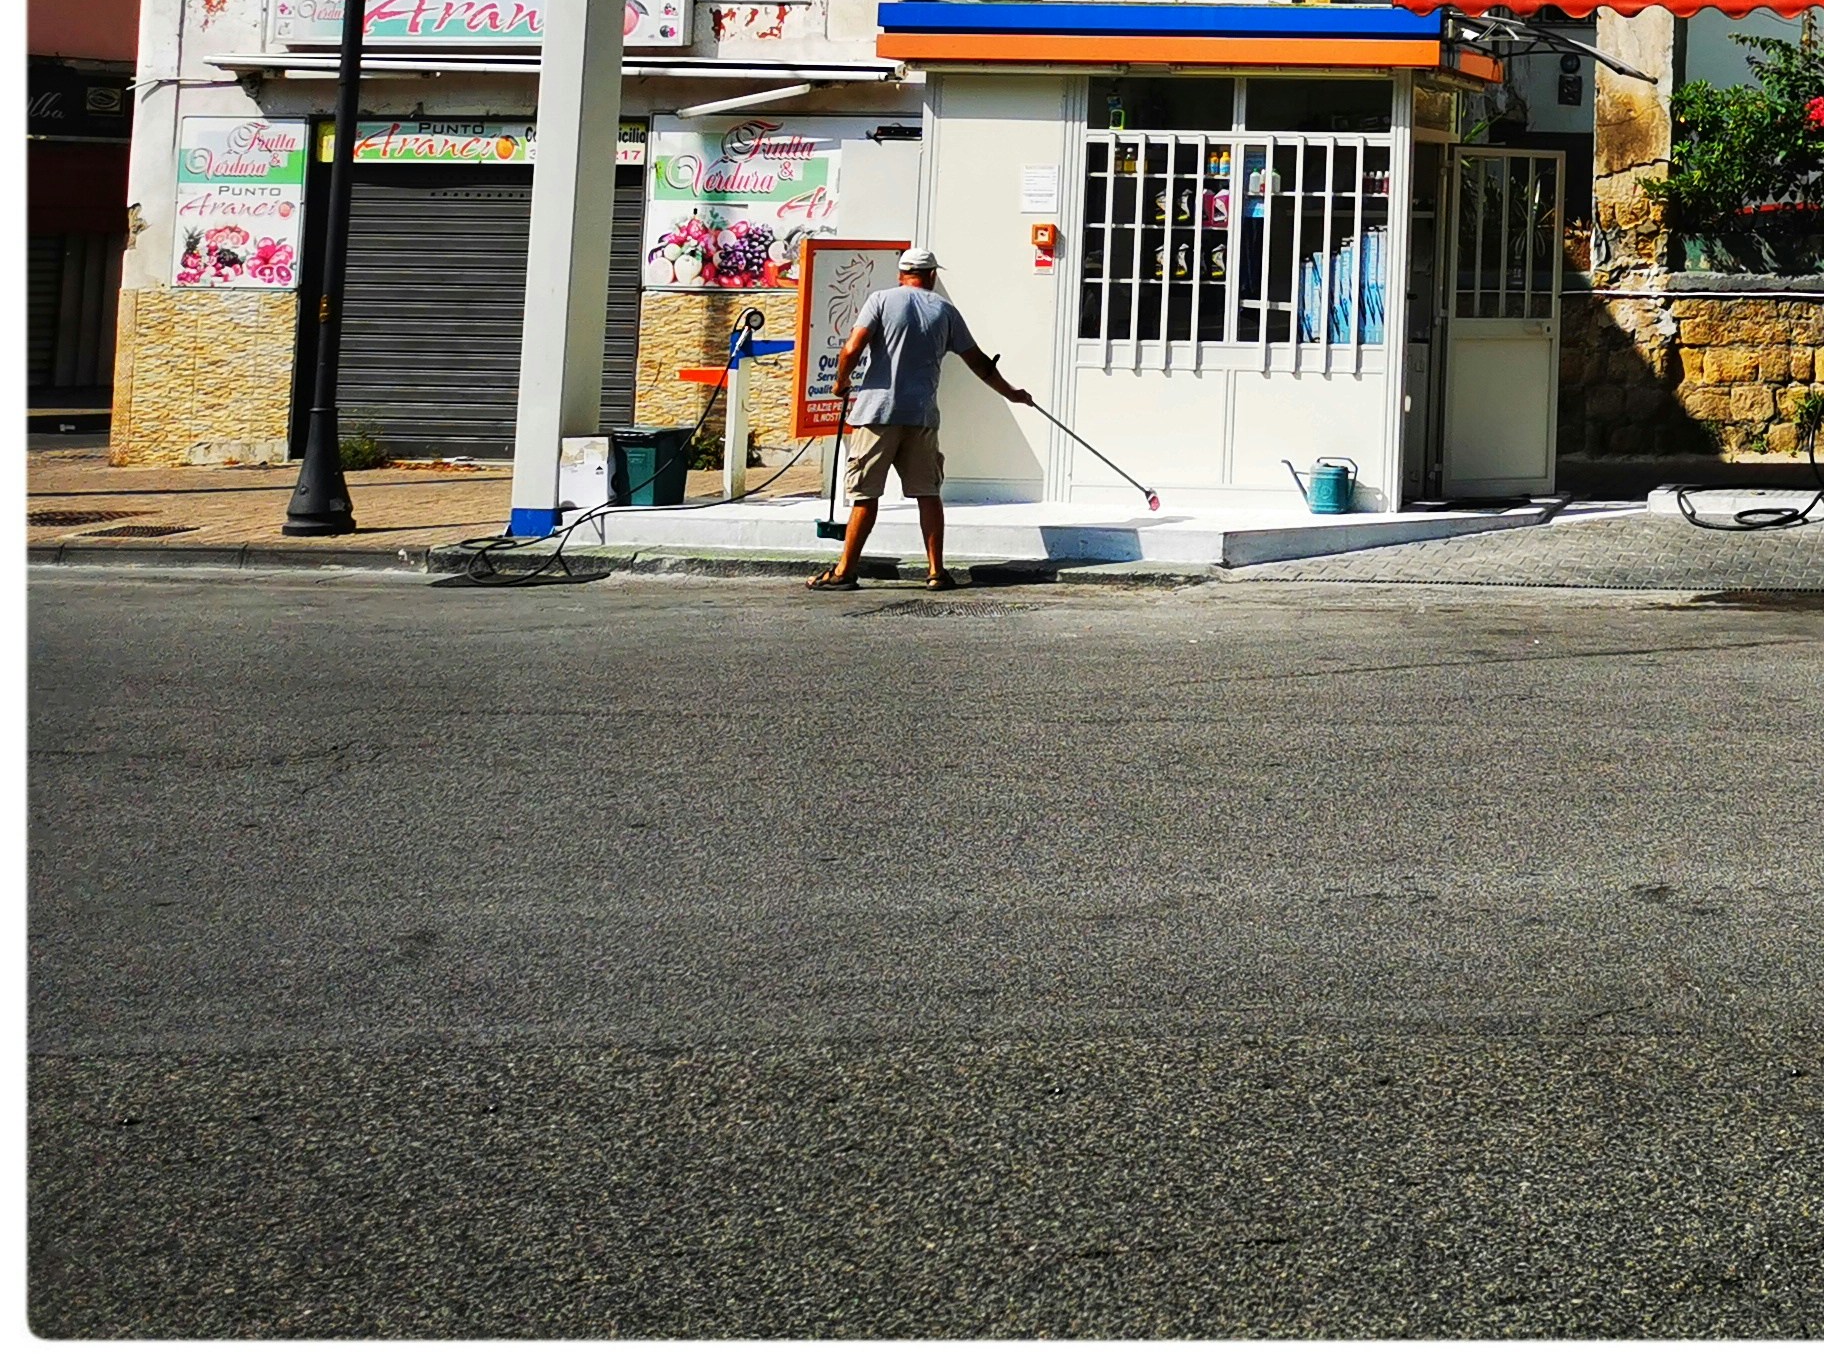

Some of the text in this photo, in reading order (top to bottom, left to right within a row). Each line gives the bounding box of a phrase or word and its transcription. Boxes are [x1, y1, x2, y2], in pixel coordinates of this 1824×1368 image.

[227, 122, 296, 155] Frutta
[721, 120, 816, 163] Frutta
[185, 148, 268, 180] Verdura
[616, 150, 641, 161] 17
[666, 154, 777, 196] Verdura
[808, 384, 833, 397] Qualit
